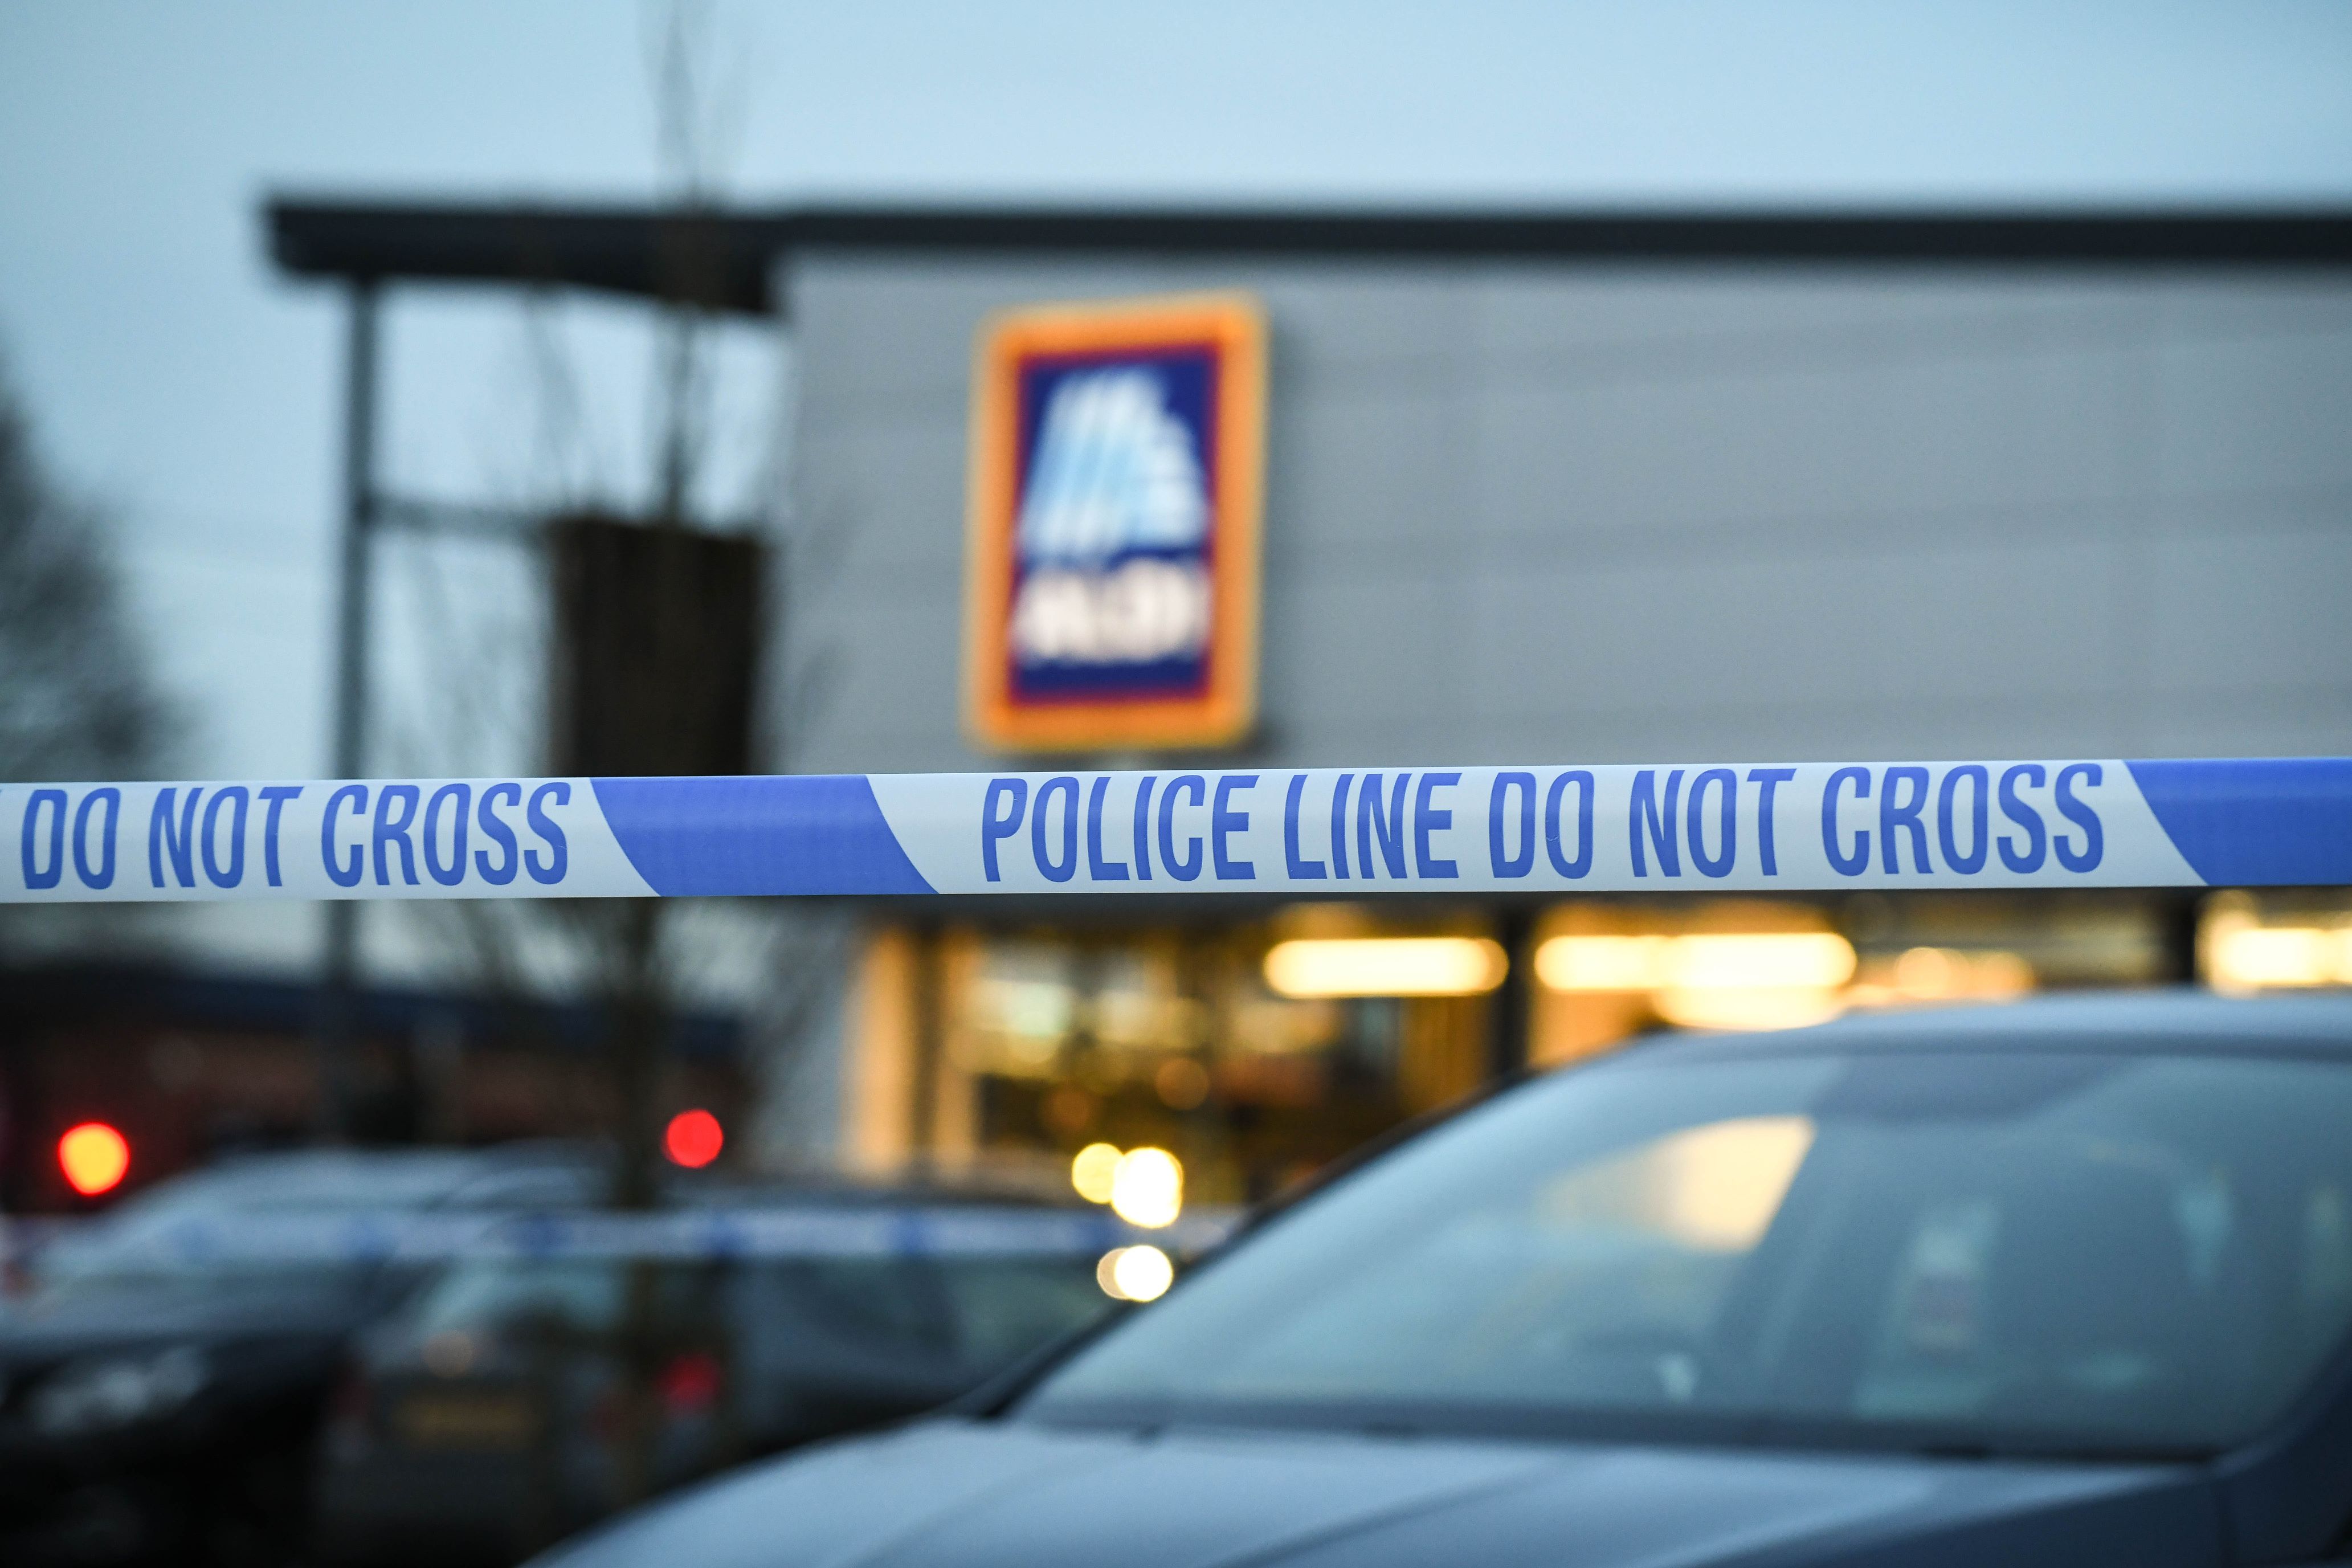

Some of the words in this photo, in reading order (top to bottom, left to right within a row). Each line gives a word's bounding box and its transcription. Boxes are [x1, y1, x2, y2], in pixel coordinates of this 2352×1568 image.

[21, 787, 121, 891] DO
[148, 785, 305, 890] NOT
[321, 782, 571, 888] CROSS
[982, 775, 1261, 883] POLICE
[1284, 773, 1463, 880] LINE
[1489, 770, 1595, 880] DO
[1629, 767, 1796, 879] NOT
[1821, 761, 2105, 877] CROSS
